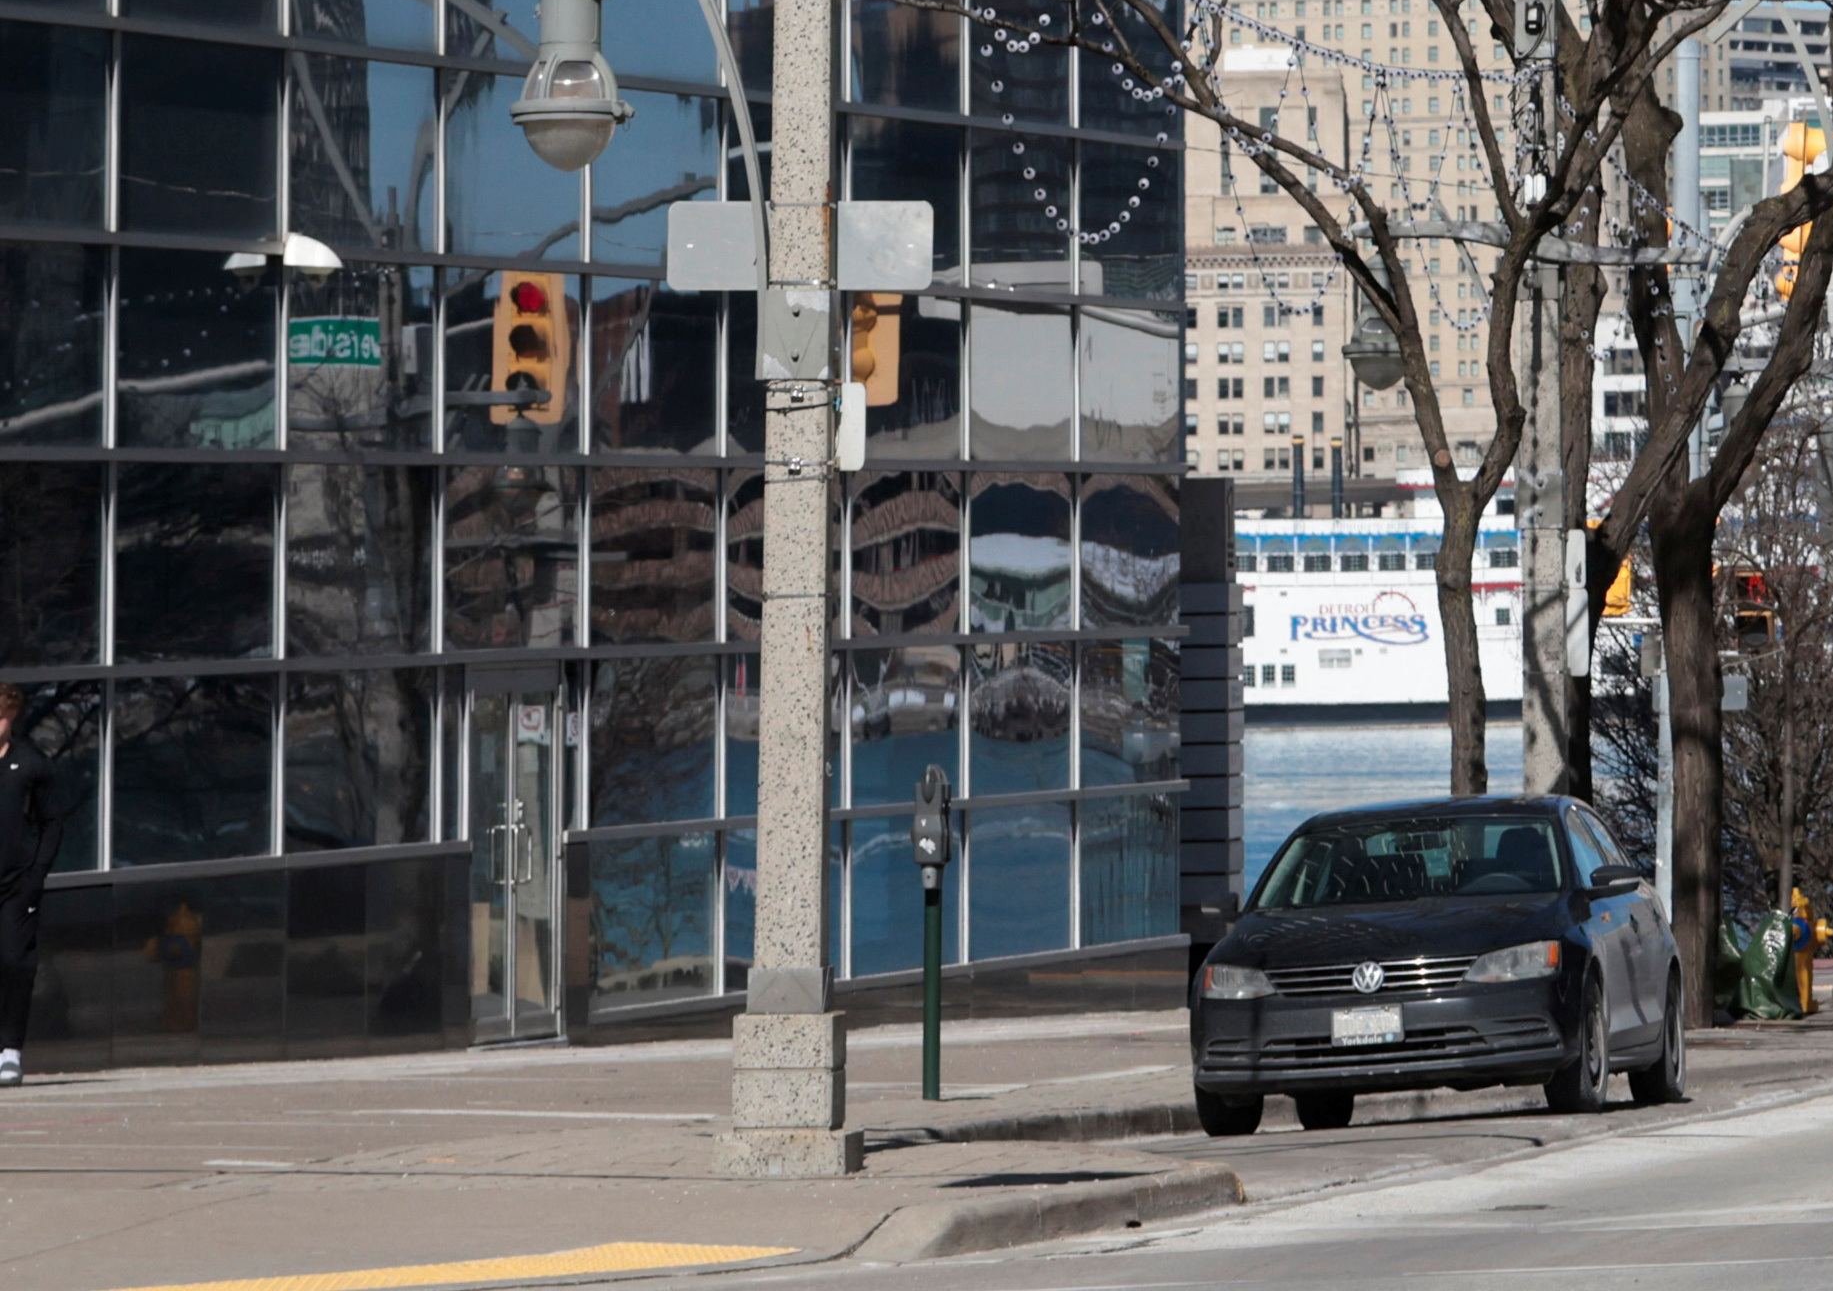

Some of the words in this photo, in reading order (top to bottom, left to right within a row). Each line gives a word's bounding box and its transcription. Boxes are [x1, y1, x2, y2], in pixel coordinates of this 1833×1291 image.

[1318, 603, 1376, 616] DETROIT
[1289, 614, 1430, 645] PRINCESS
[1341, 1033, 1383, 1046] Yorkdale
